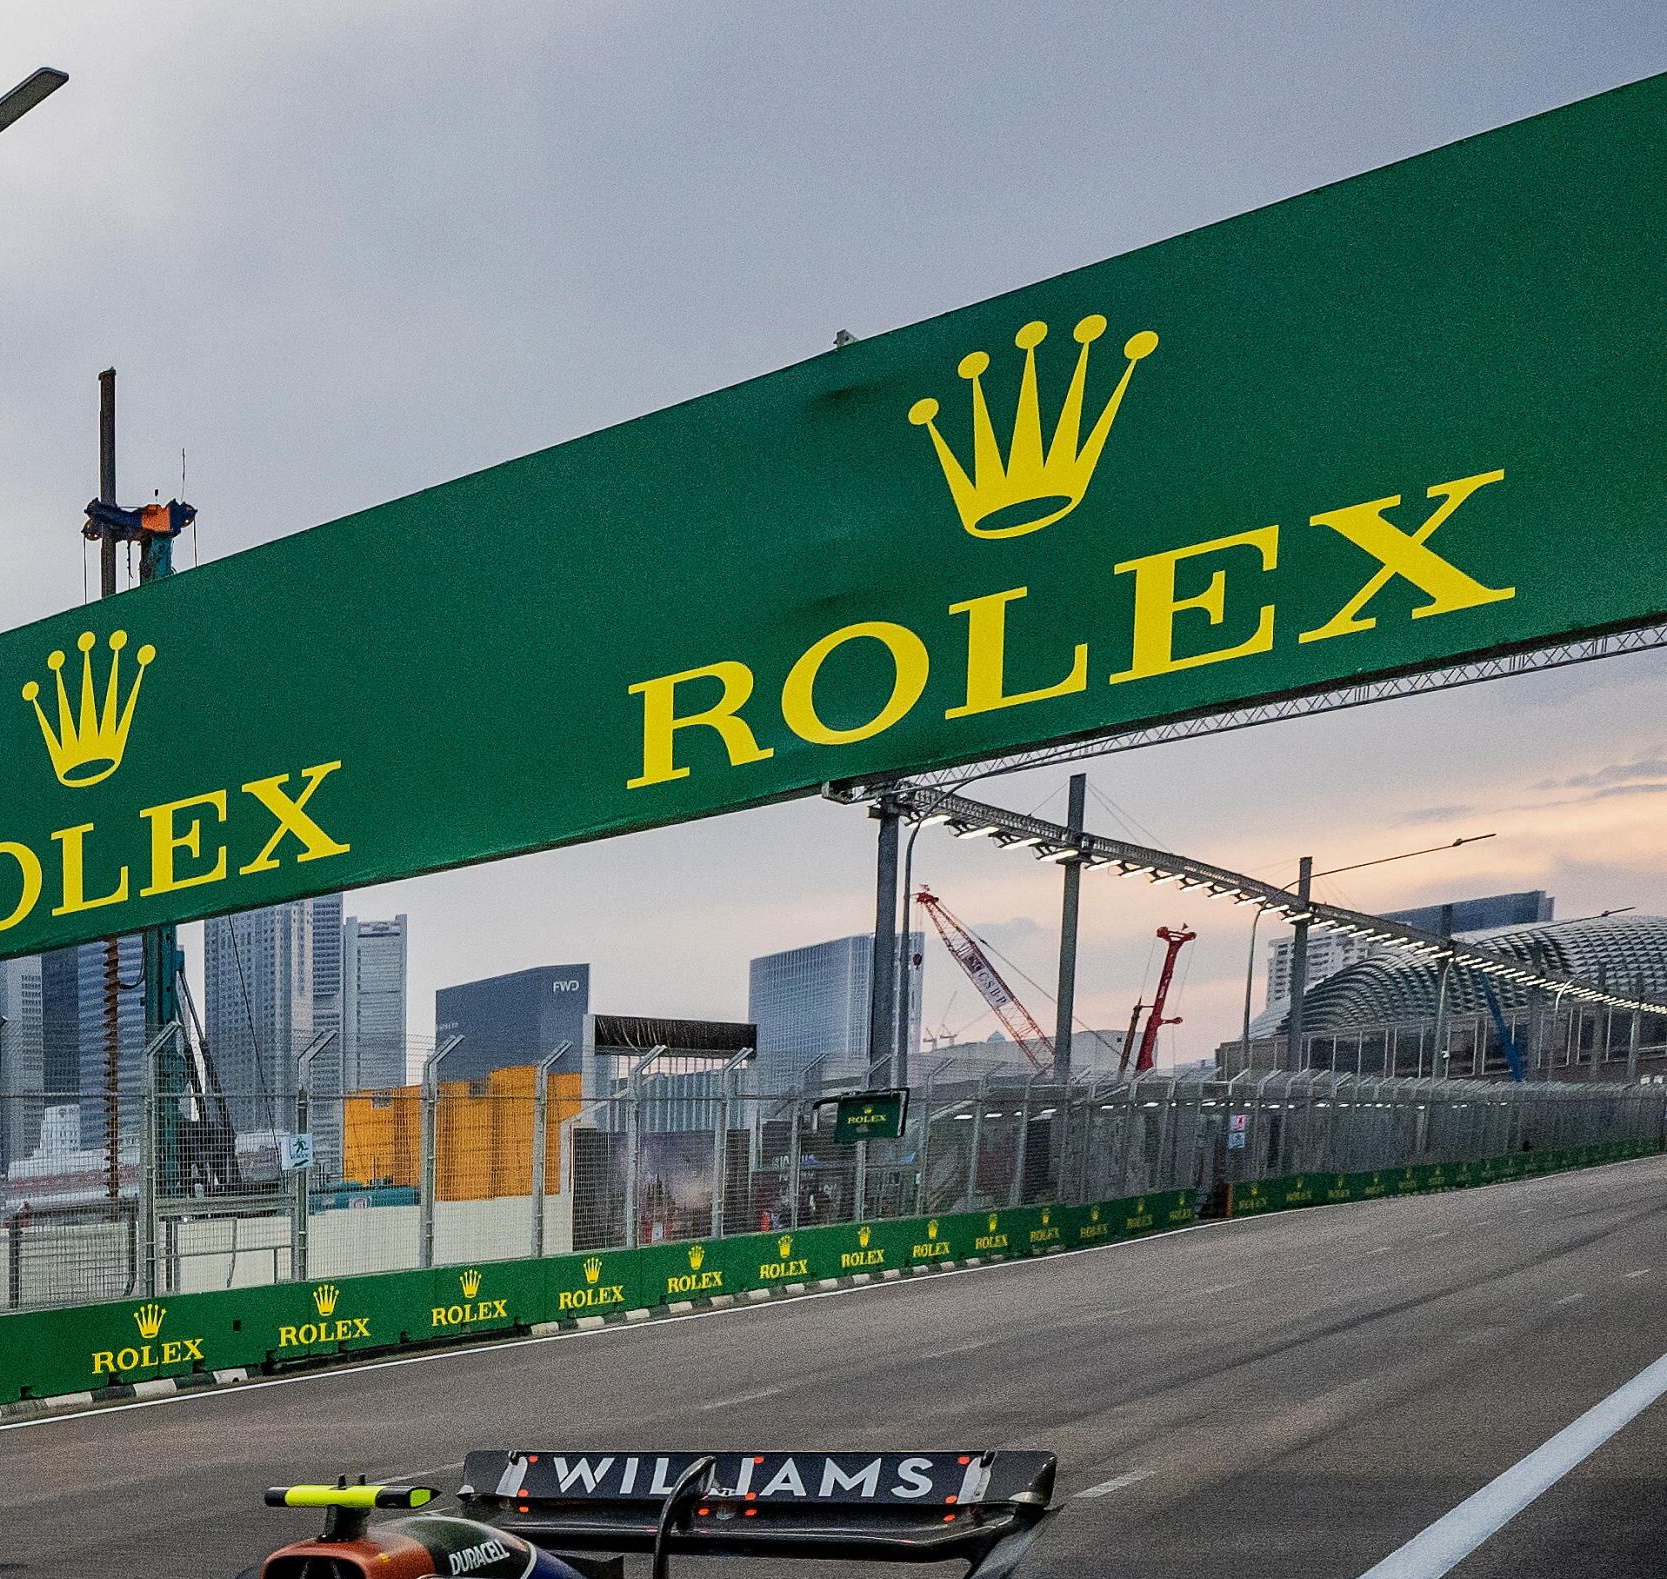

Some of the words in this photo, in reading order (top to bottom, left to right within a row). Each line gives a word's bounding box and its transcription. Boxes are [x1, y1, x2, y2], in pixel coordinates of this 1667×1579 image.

[627, 468, 1517, 790] ROLEX
[553, 980, 579, 992] FWD
[847, 1113, 887, 1125] ROLEX
[912, 1241, 950, 1258] ROLEX
[975, 1234, 1008, 1250] ROLEX
[758, 1259, 808, 1279] ROLEX
[841, 1249, 885, 1267] ROLEX
[667, 1270, 723, 1293] ROLEX
[558, 1284, 624, 1311] ROLEX
[431, 1299, 508, 1327] ROLEX
[278, 1317, 371, 1347] ROLEX
[91, 1338, 205, 1375] ROLEX
[553, 1456, 934, 1497] WILIAMS
[448, 1539, 511, 1576] DURACELL
